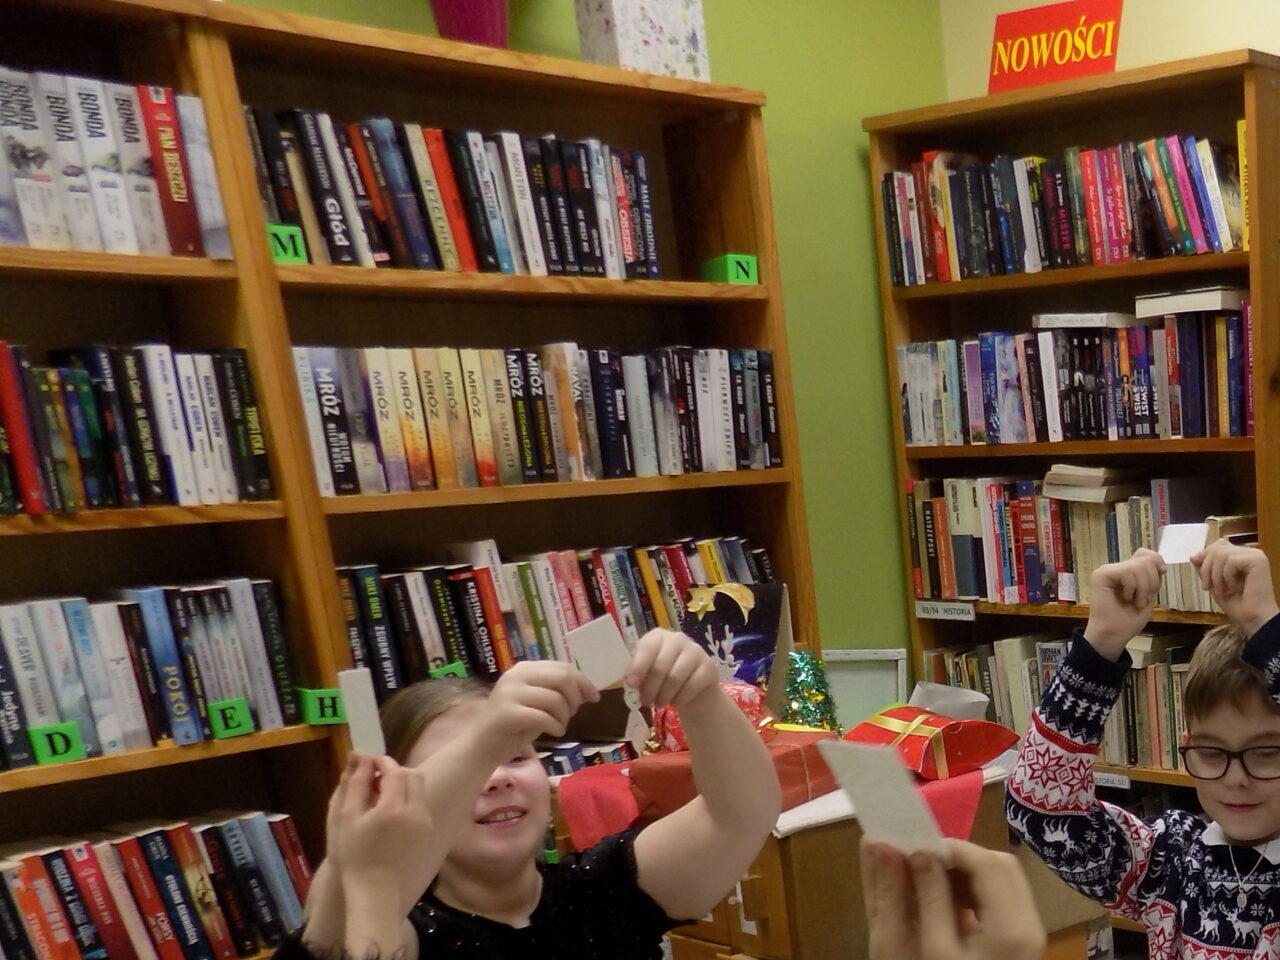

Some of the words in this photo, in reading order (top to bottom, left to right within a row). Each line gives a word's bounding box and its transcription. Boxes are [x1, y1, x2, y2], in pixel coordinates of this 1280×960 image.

[992, 16, 1116, 76] NOWOŚCI
[15, 84, 39, 131] BONDA
[46, 96, 76, 142] BONDA
[78, 92, 107, 138] BONDA
[115, 97, 140, 143] BONDA
[511, 152, 528, 200] MORTON
[325, 198, 350, 247] Głód
[271, 233, 299, 258] M
[736, 260, 750, 280] N
[316, 368, 341, 417] MRÓZ
[424, 370, 439, 418] MRÓZ
[467, 370, 482, 418] MRÓZ
[493, 378, 506, 404] MRÓZ
[506, 354, 524, 398] MRÓZ
[527, 353, 543, 396] MRÓZ
[571, 366, 583, 403] NAVAL
[373, 371, 390, 421] MRÓZ
[398, 372, 415, 421] MRÓZ
[444, 372, 459, 420] MRÓZ
[1133, 387, 1142, 416] SWIST
[1140, 386, 1149, 415] SWIST
[364, 576, 375, 596] MIKE
[596, 568, 612, 604] ROGALA
[611, 568, 627, 609] RUDNICKA
[369, 597, 383, 619] OMER
[466, 582, 484, 624] KRISTINA
[479, 626, 498, 673] OHLSSON
[943, 607, 972, 617] HISTORIA
[17, 636, 37, 673] DEAVER
[375, 626, 389, 658] ZGUBNY
[220, 706, 242, 731] E
[318, 696, 339, 719] H
[45, 732, 71, 756] D
[156, 912, 176, 942] FORSY
